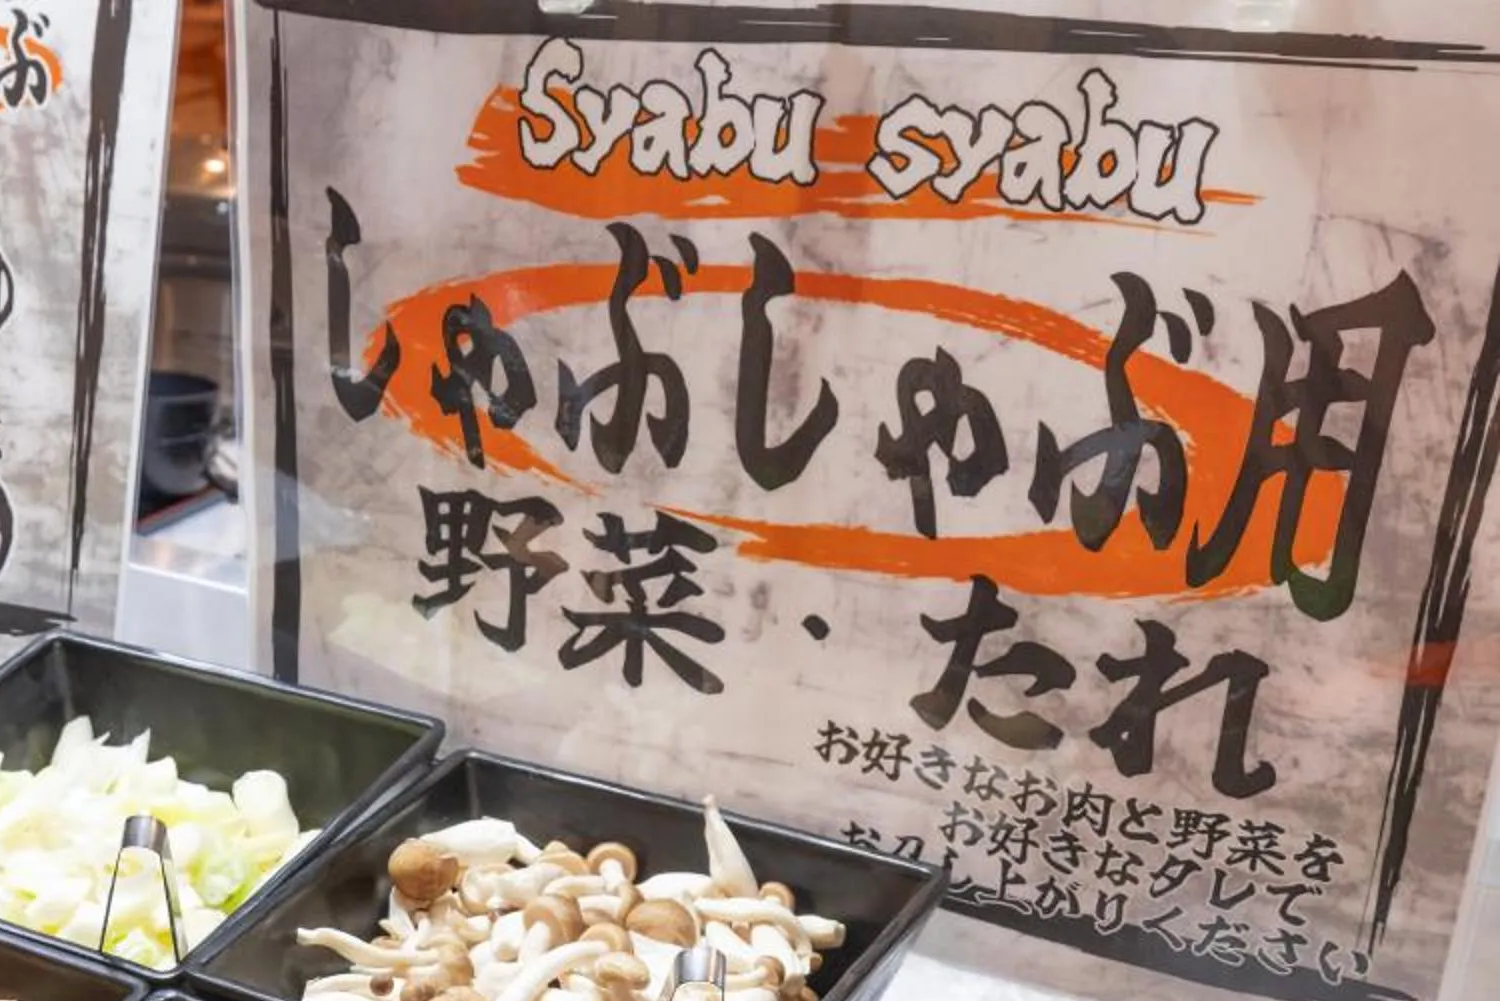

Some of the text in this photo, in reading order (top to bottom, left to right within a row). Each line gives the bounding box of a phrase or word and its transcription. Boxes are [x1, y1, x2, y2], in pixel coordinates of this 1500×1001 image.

[867, 69, 1218, 224] syabu
[325, 186, 1436, 623] しゃぶしゃぶ用
[813, 719, 1346, 883] お好きなお肉と野菜を
[940, 800, 1324, 928] お好きなタレで
